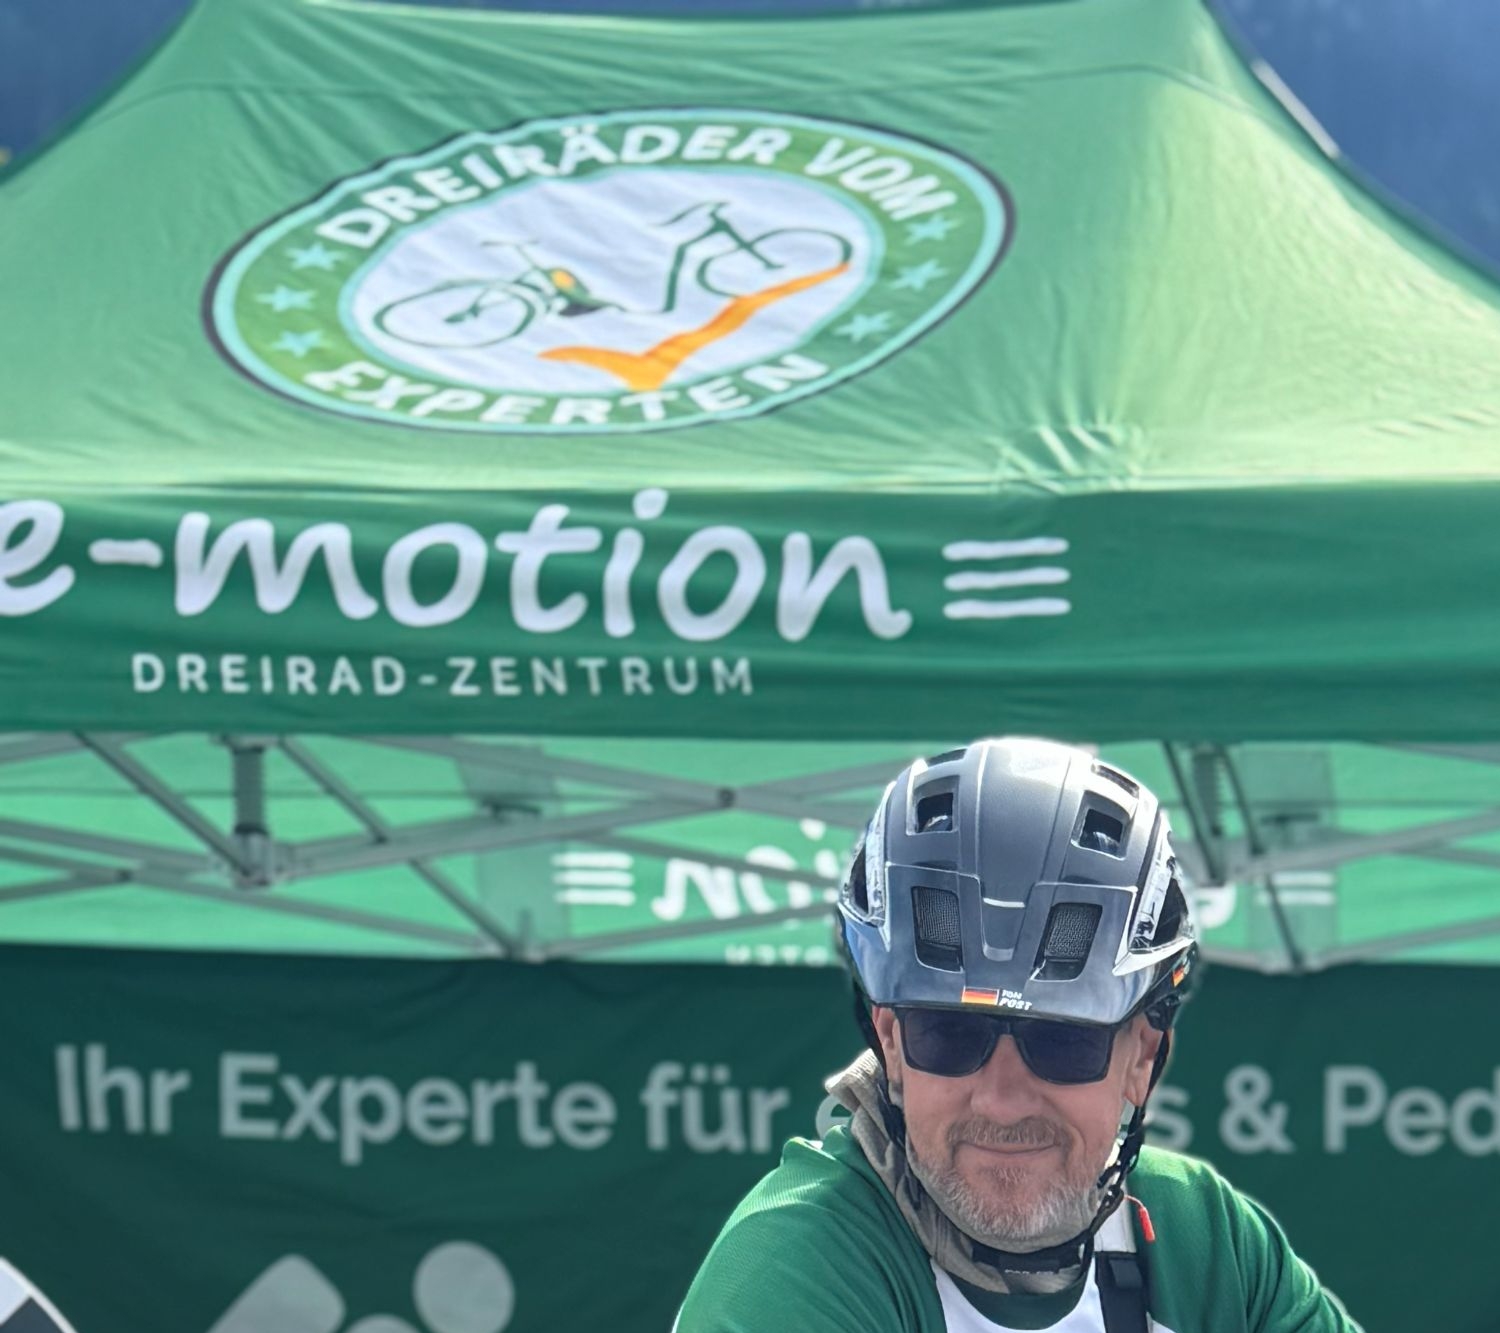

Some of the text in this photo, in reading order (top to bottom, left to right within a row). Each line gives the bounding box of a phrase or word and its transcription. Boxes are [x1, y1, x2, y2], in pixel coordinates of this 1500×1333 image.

[316, 122, 958, 250] DREIRÄDER VOM
[305, 354, 829, 426] EXPERTEN
[0, 488, 912, 641] e-motion
[131, 652, 756, 697] DREIRAD-ZENTRUM
[55, 1044, 190, 1134] Ihr
[218, 1051, 618, 1166] Experte
[641, 1060, 790, 1153] für
[1219, 1064, 1296, 1155] &
